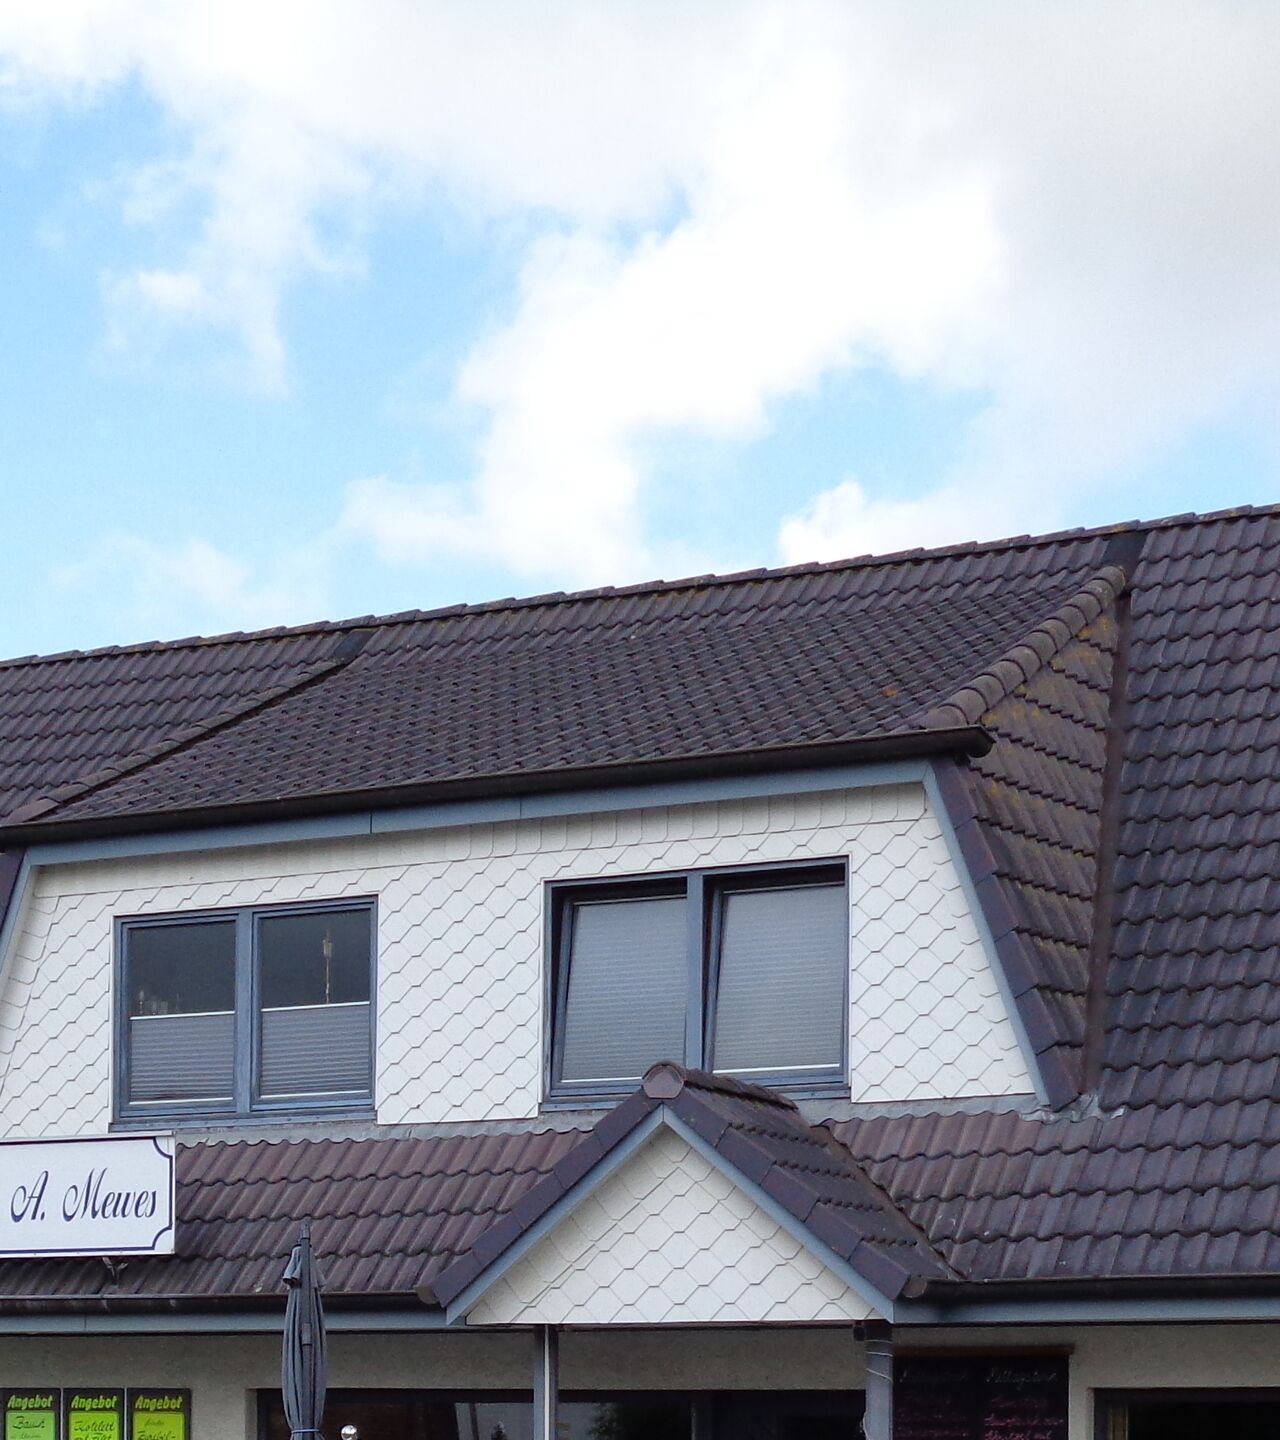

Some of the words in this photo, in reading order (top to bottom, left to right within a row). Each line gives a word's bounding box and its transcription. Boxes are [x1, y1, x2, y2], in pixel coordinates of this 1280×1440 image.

[10, 1170, 47, 1222] A.
[62, 1167, 157, 1221] Mewes
[7, 1394, 54, 1411] Angebot
[71, 1395, 118, 1411] Angebot
[135, 1396, 183, 1412] Angebot
